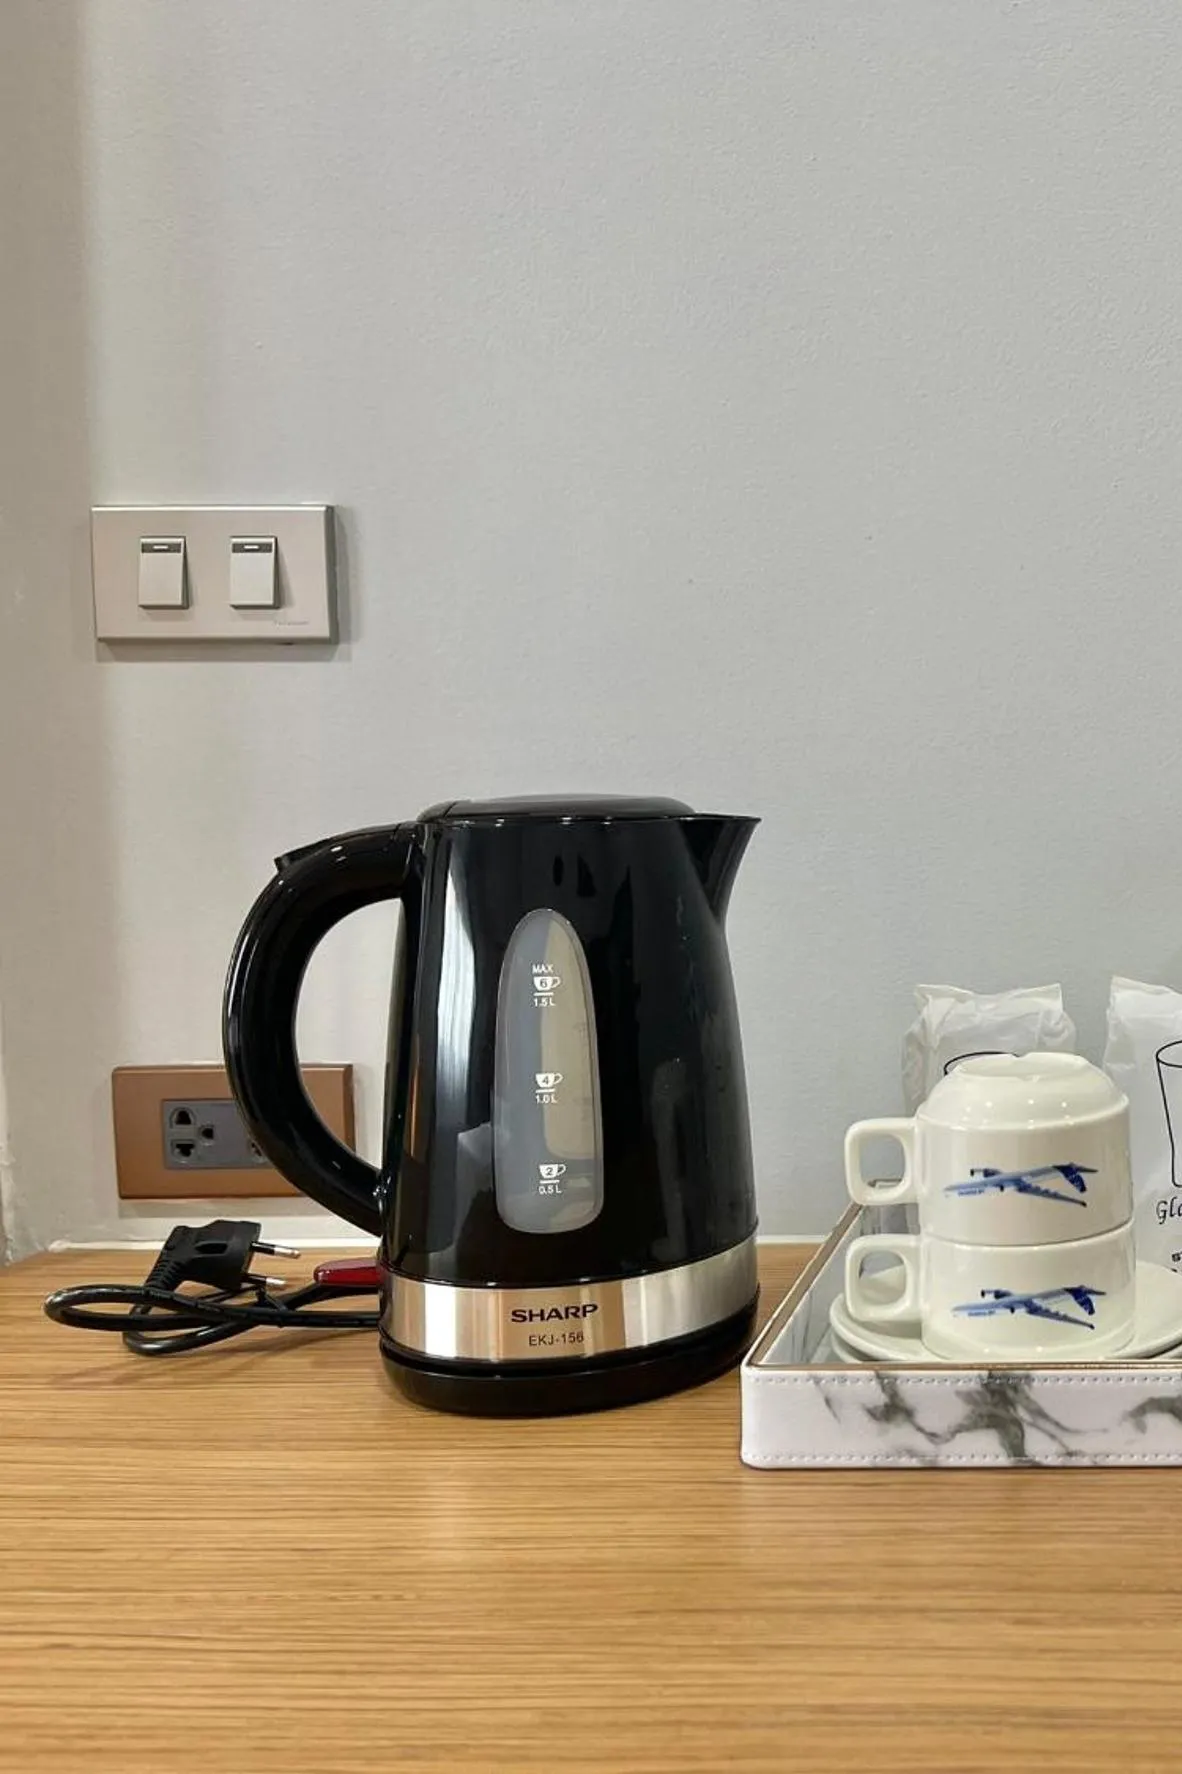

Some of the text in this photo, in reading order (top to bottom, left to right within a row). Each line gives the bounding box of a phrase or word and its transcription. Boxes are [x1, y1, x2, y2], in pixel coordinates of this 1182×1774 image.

[532, 963, 554, 974] MAX
[511, 1304, 599, 1323] SHARP
[528, 1331, 585, 1347] EKJ-156
